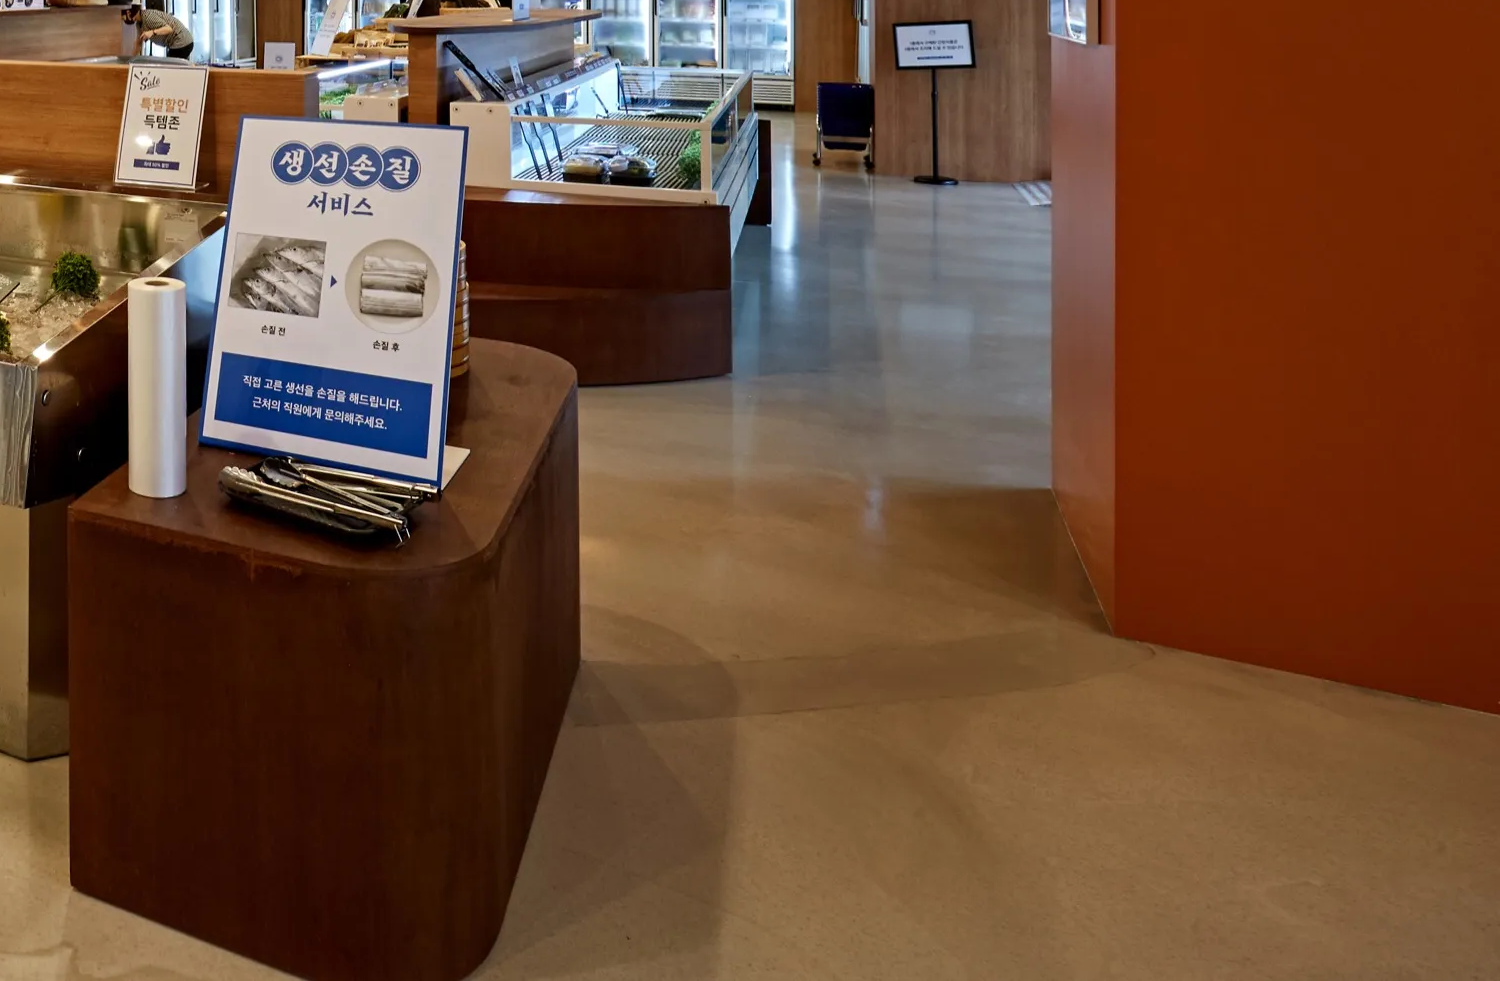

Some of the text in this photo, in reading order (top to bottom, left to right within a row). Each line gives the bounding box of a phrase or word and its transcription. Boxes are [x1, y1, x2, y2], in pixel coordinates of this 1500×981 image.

[140, 75, 160, 91] Sale
[140, 96, 189, 114] 특별할인
[143, 114, 181, 131] 득템존
[278, 148, 414, 185] 생선손질
[306, 191, 374, 217] 서비스
[261, 324, 286, 337] 손질 전
[372, 340, 400, 352] 손질 후
[243, 375, 403, 411] 직접 고른 생선을 손질을 해드립니다.
[252, 396, 387, 430] 근처의 직원에게 문의해주세요.
